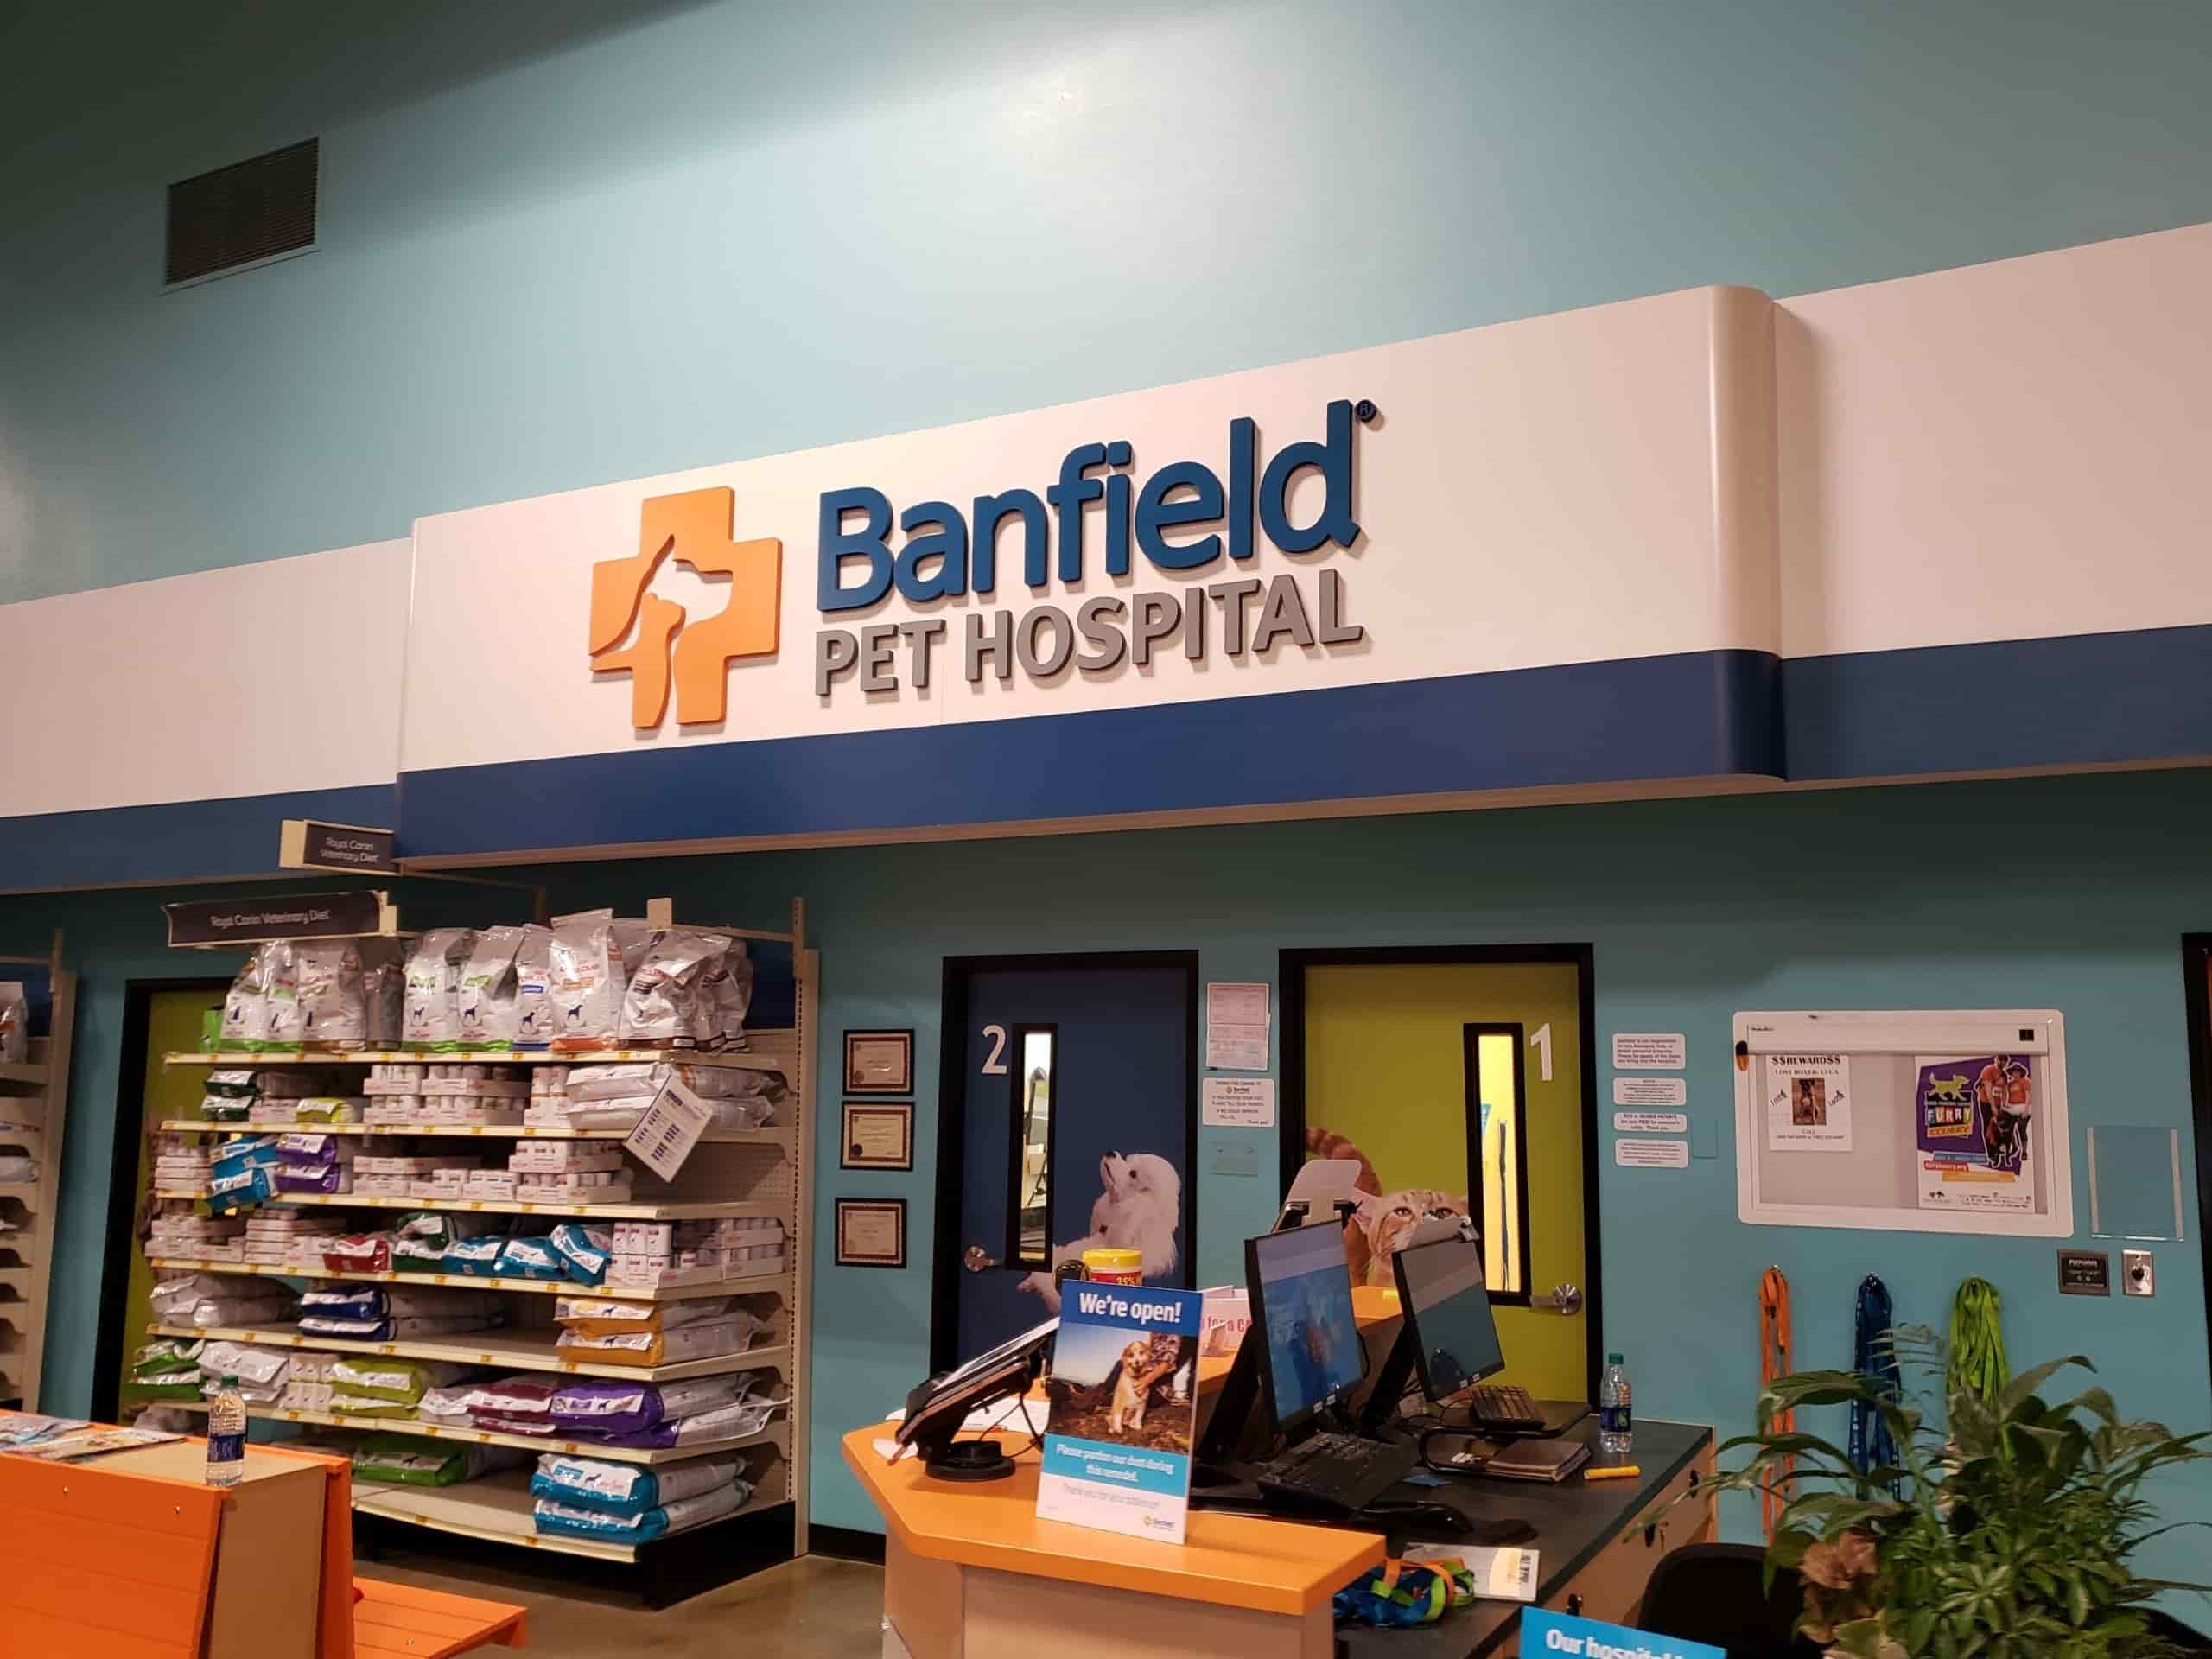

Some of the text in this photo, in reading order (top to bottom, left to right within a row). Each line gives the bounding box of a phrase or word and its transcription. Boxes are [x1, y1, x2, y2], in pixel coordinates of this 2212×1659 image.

[815, 568, 1364, 697] PET HOSPITAL
[981, 1024, 1007, 1074] 2
[1530, 1023, 1553, 1081] 1
[1927, 1107, 1971, 1122] FURRY
[1079, 1292, 1183, 1325] We're open!
[1545, 1628, 1585, 1655] Our
